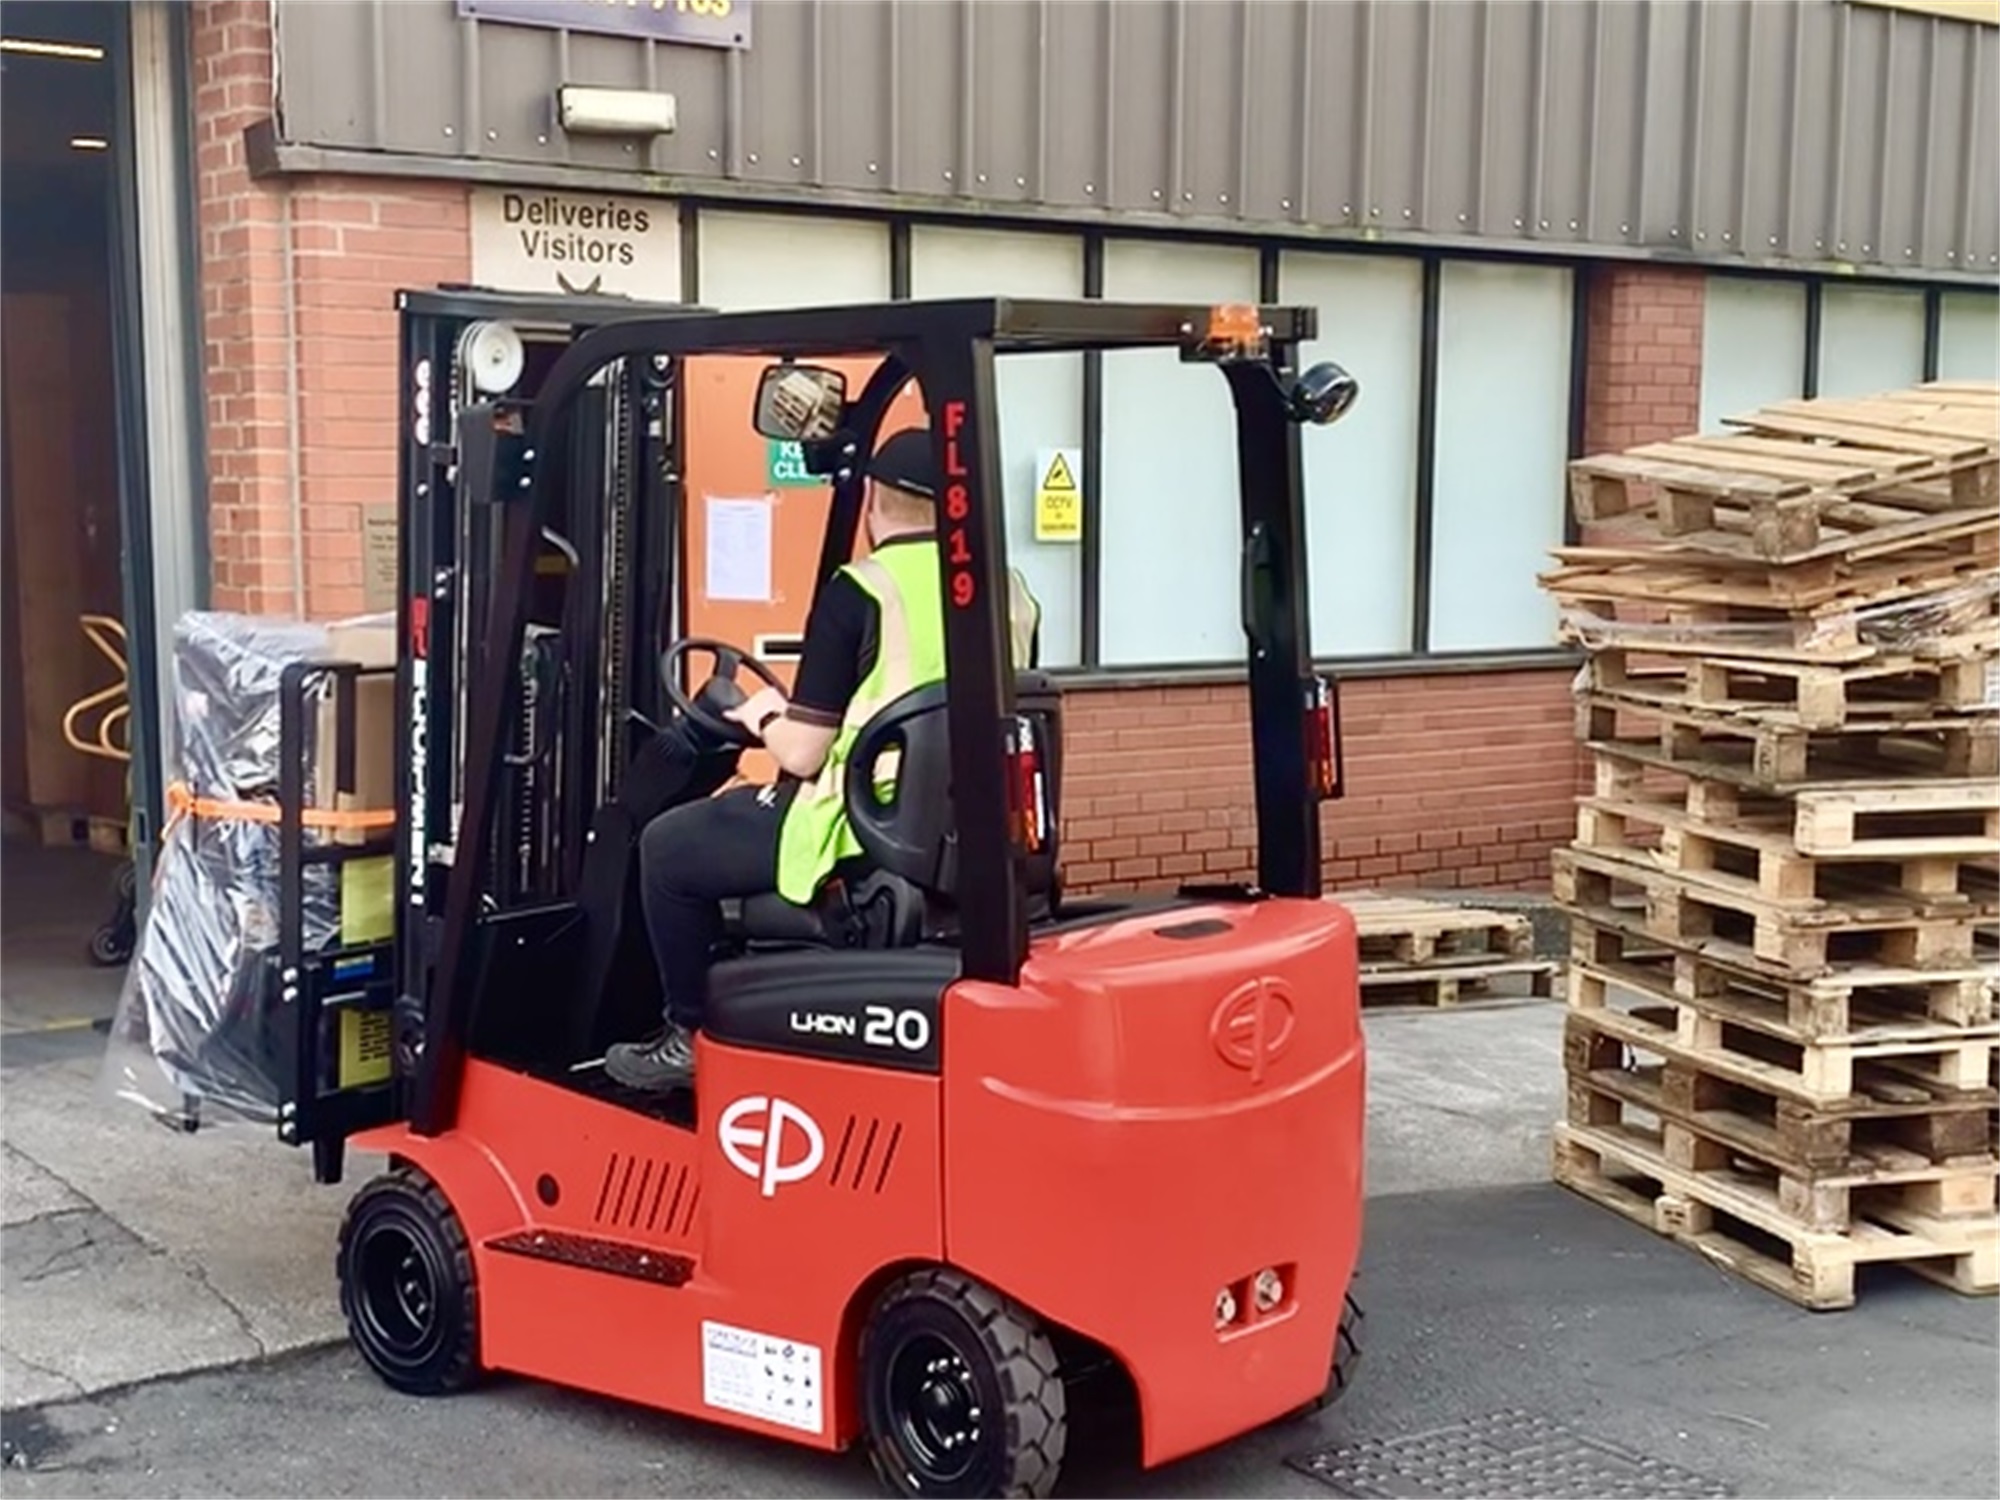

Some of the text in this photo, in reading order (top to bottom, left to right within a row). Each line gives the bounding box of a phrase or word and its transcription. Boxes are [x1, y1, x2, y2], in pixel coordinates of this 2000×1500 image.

[503, 193, 650, 233] Deliveries
[520, 229, 635, 266] Visitors
[780, 440, 804, 459] KE
[773, 461, 810, 479] CLE
[944, 401, 975, 607] FL819
[864, 1005, 930, 1050] 20
